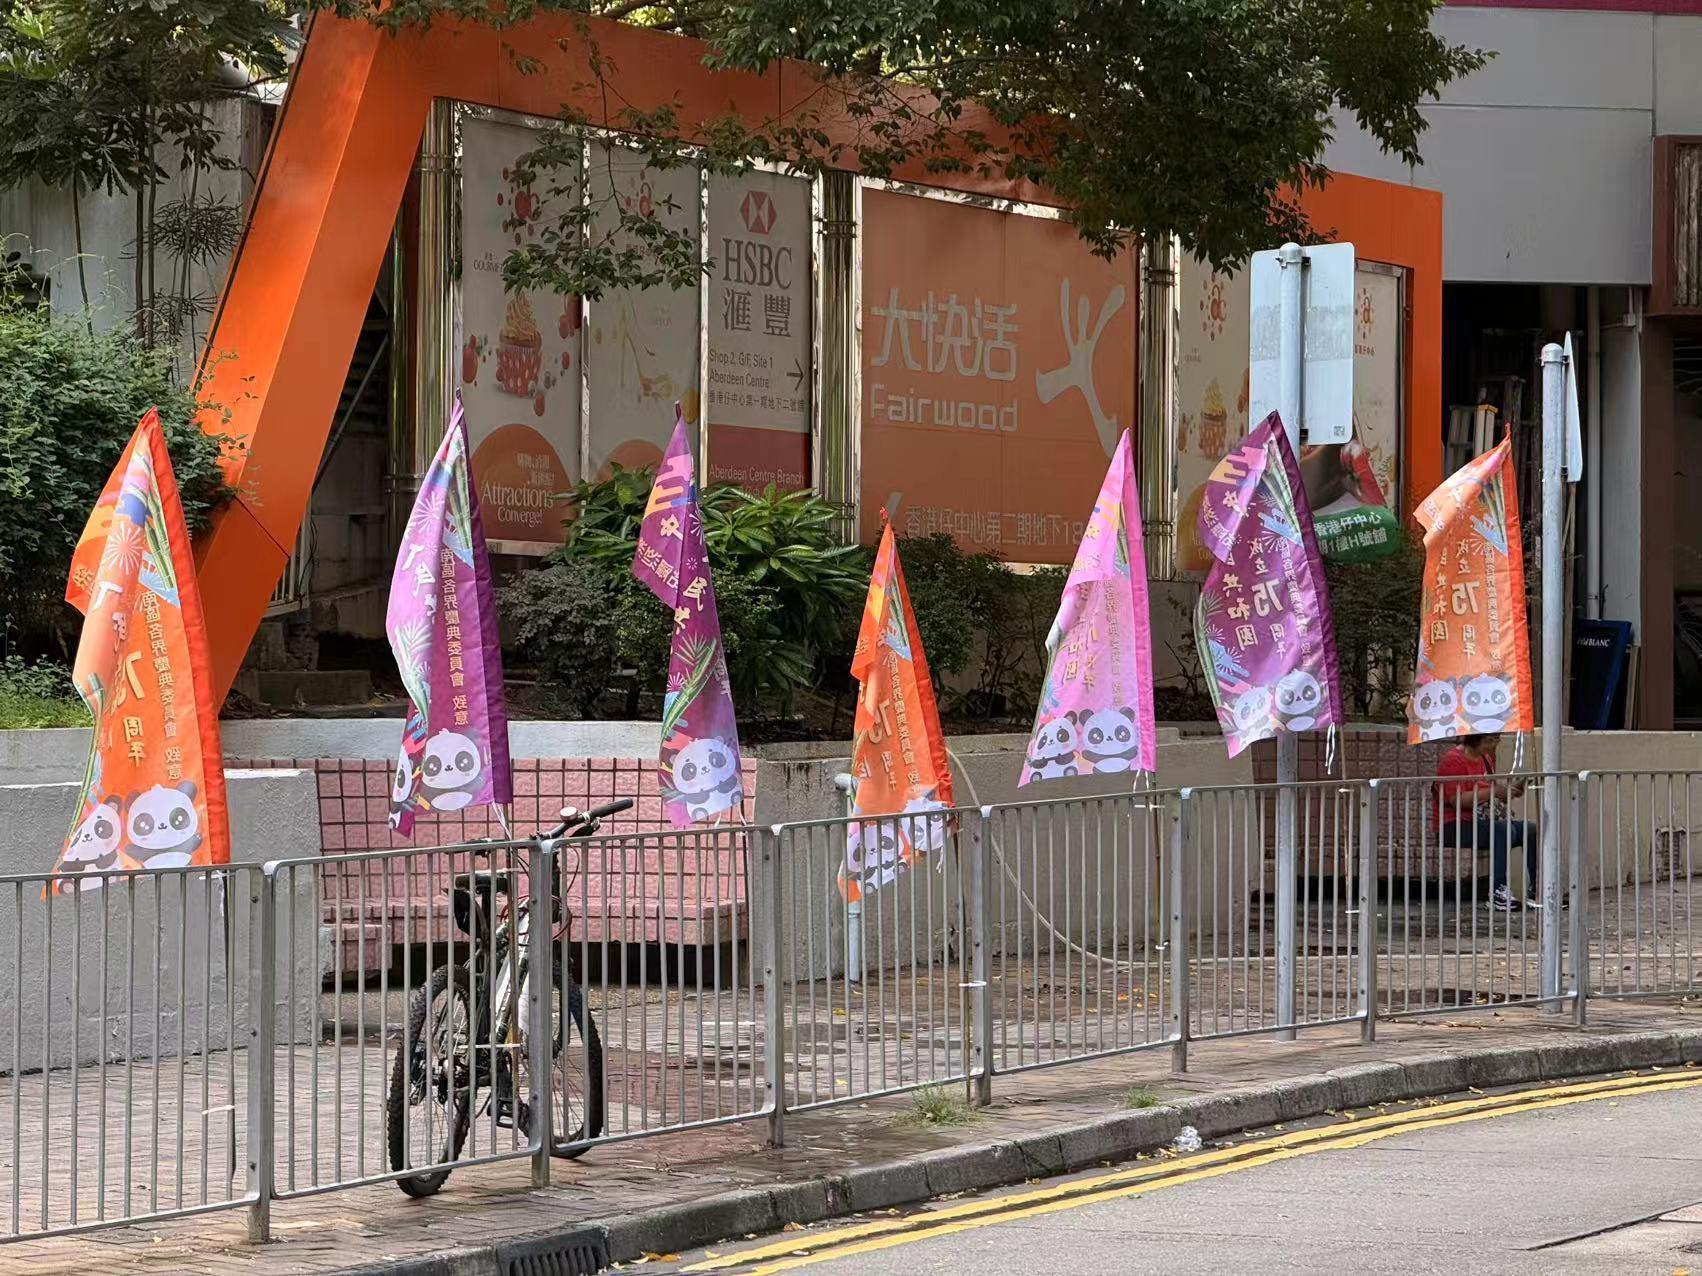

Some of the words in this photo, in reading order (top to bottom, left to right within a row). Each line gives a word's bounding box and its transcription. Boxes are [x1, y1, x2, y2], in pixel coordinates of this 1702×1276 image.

[722, 238, 793, 290] HSBC
[869, 287, 1020, 382] 大快活
[709, 348, 729, 364] Shop
[753, 354, 768, 368] Site
[709, 370, 744, 387] Aberdeen
[746, 374, 770, 389] Centre
[870, 382, 1019, 431] Fairwood
[709, 463, 747, 481] Aberdeen
[749, 466, 775, 482] Centre
[777, 468, 804, 485] Branch
[481, 480, 554, 509] Attractions
[1314, 511, 1382, 536] 香港仔中心
